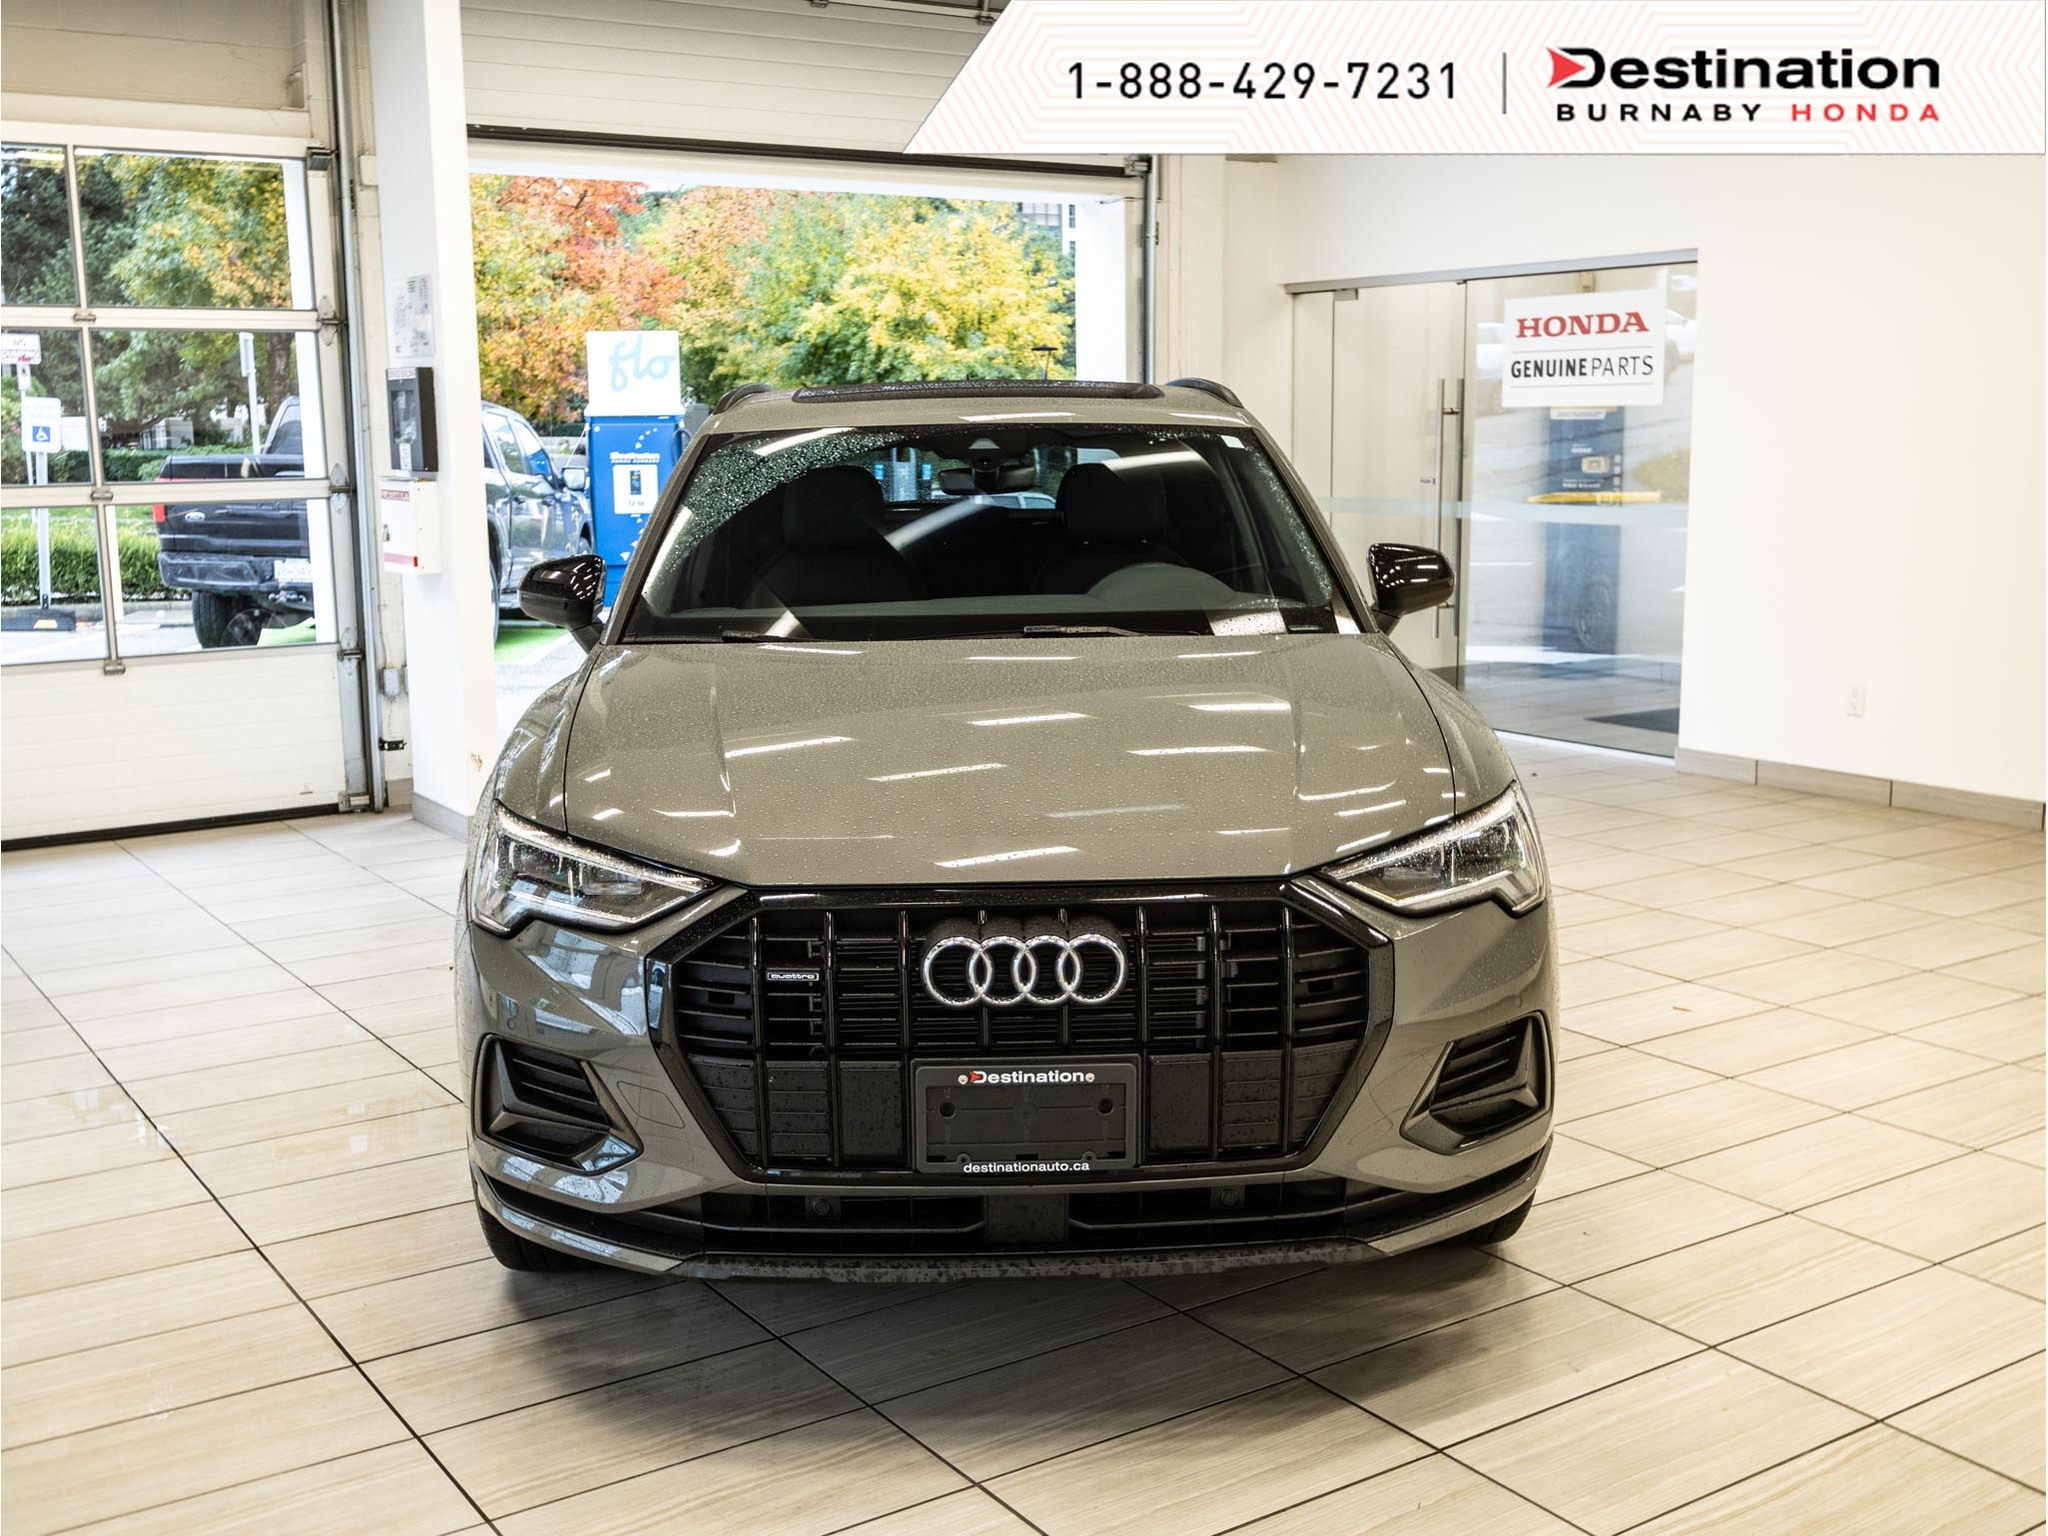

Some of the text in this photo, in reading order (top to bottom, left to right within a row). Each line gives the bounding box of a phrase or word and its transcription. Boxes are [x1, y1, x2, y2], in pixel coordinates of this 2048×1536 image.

[1516, 311, 1649, 338] HONDA
[608, 333, 677, 392] flo
[770, 973, 815, 981] quattro
[970, 1070, 1084, 1084] Destination
[963, 1161, 1090, 1174] destinationauto.ca
